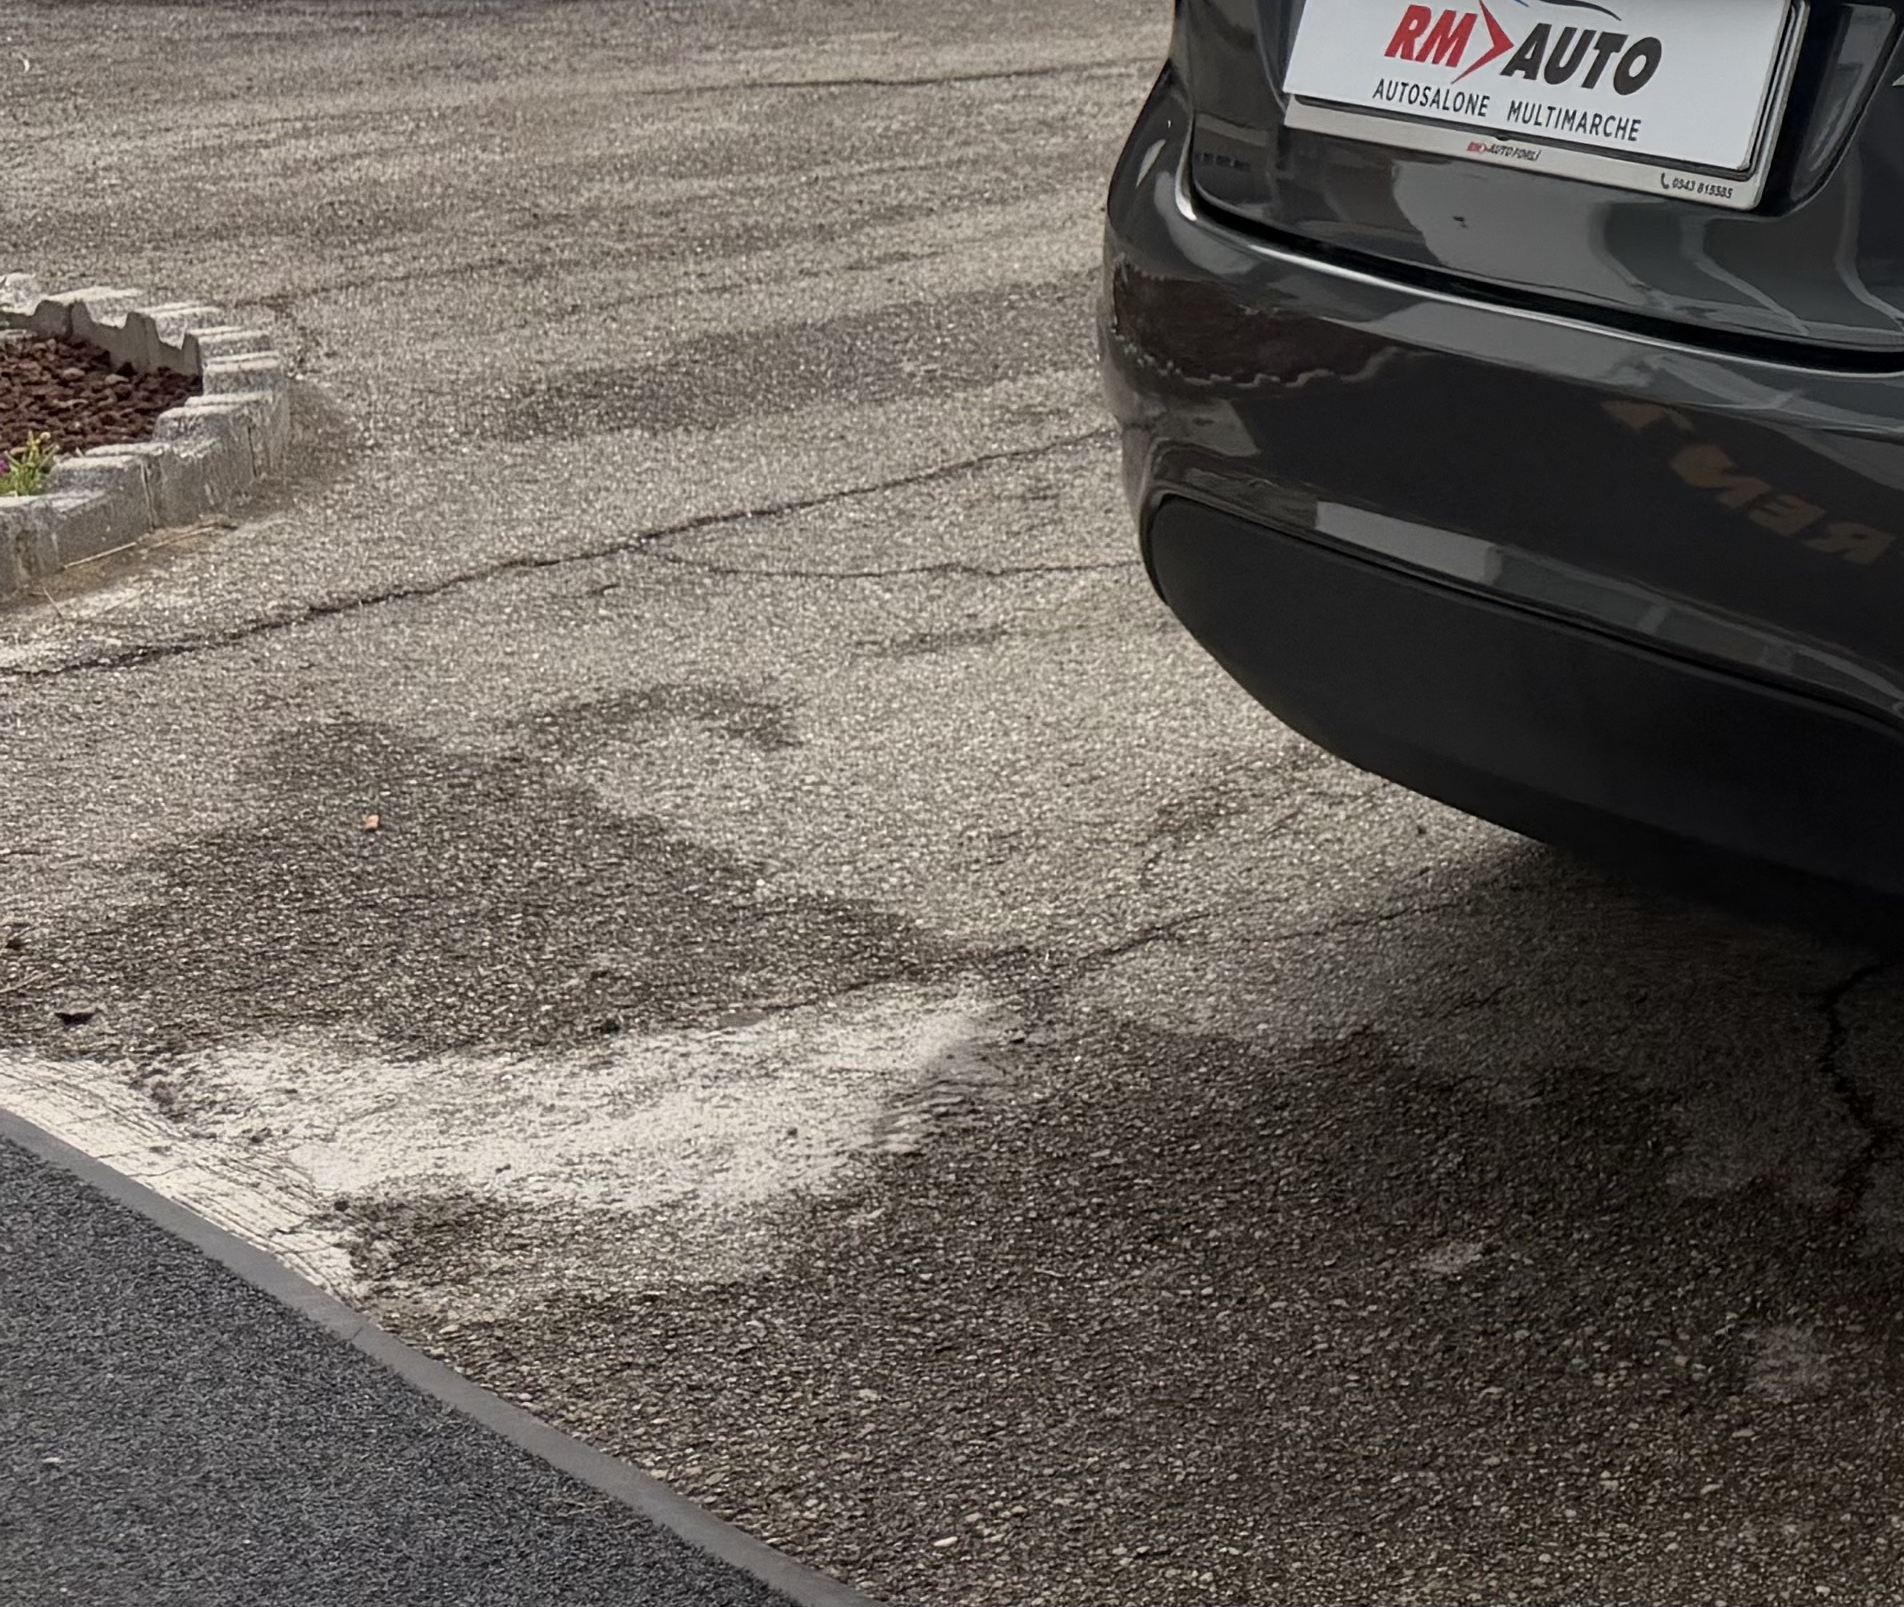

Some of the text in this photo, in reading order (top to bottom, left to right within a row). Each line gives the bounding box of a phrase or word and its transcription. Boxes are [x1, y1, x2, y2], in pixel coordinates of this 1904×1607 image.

[1383, 3, 1663, 96] RM AUTO
[1371, 77, 1643, 142] AUTOSALONE MULTIMARCHE
